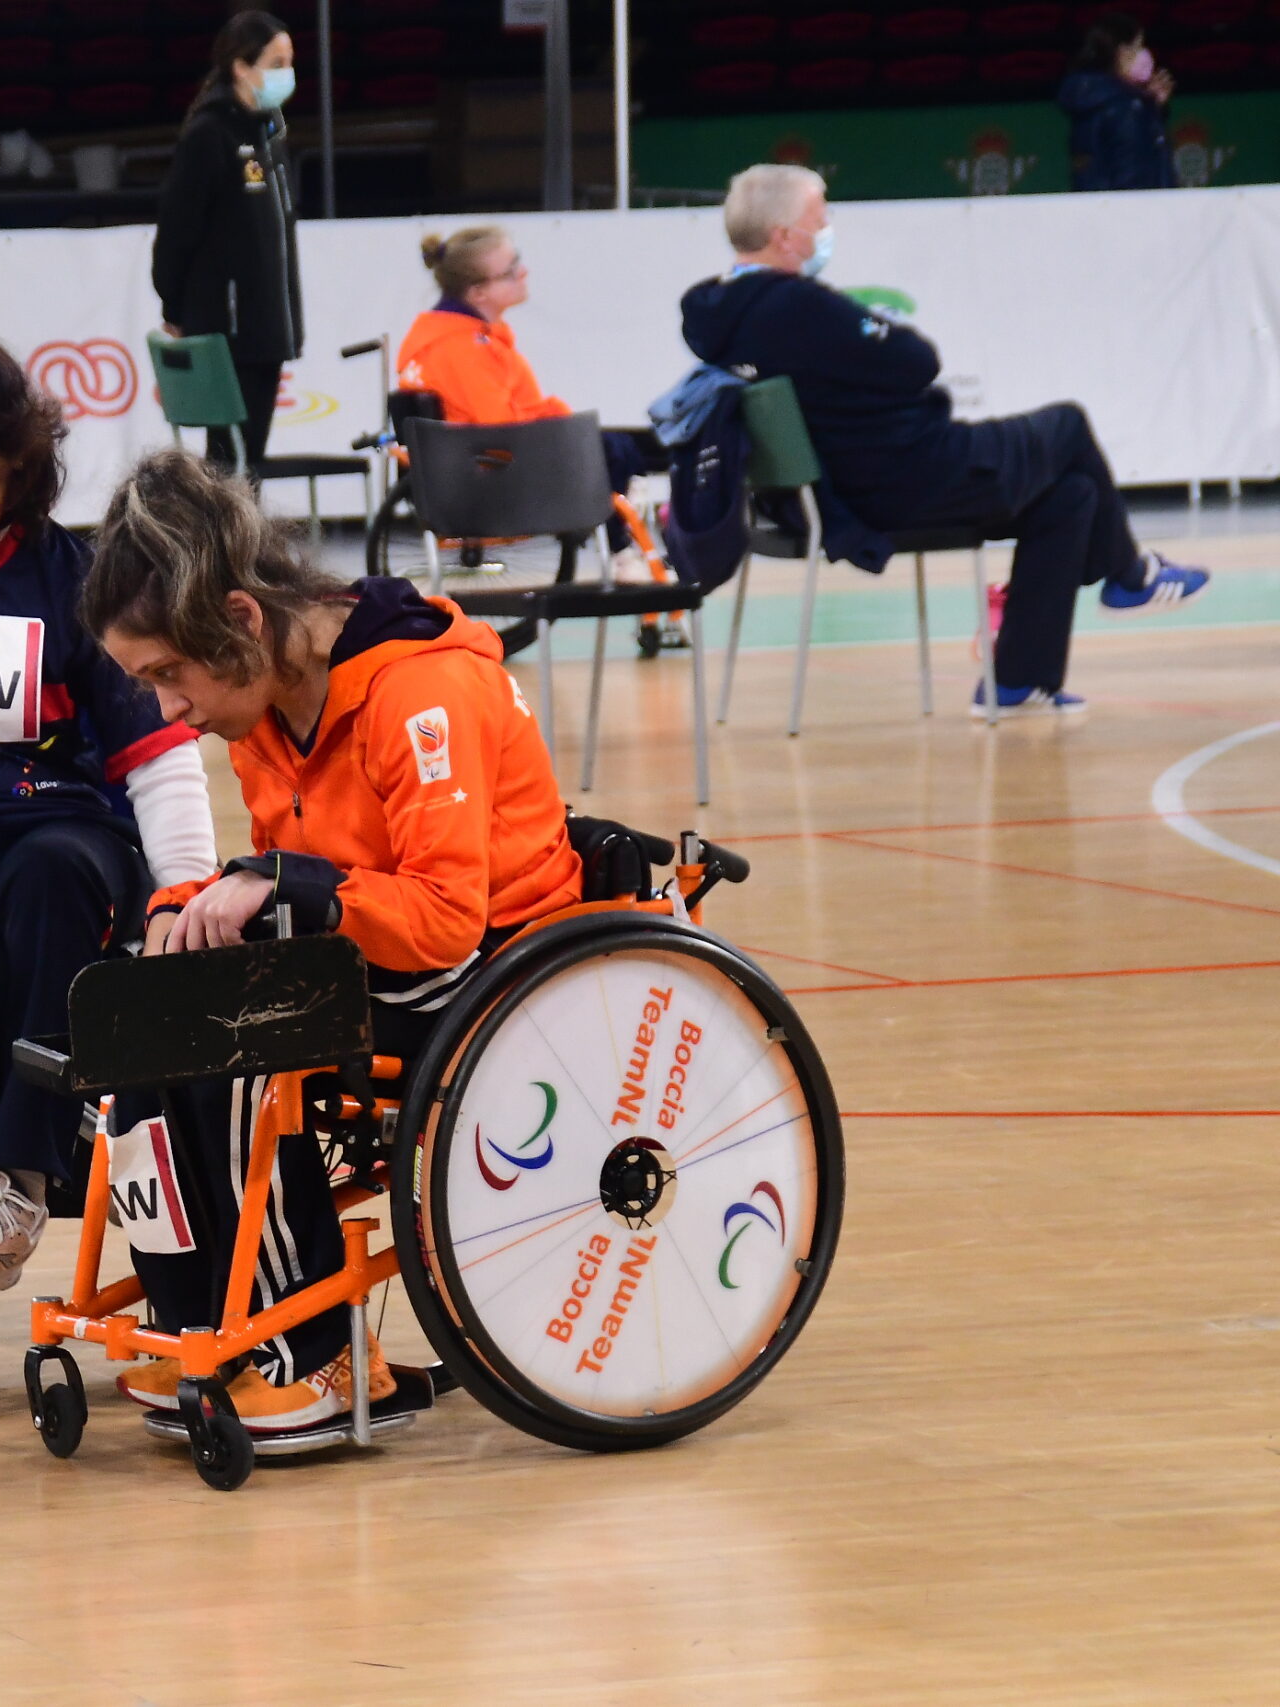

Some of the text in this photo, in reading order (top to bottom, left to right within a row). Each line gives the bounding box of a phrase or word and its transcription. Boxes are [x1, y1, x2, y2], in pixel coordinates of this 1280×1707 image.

[611, 987, 673, 1126] TeamNL
[657, 1019, 703, 1129] Boccia
[545, 1234, 611, 1344] Boccia
[575, 1235, 658, 1374] TeamNL
